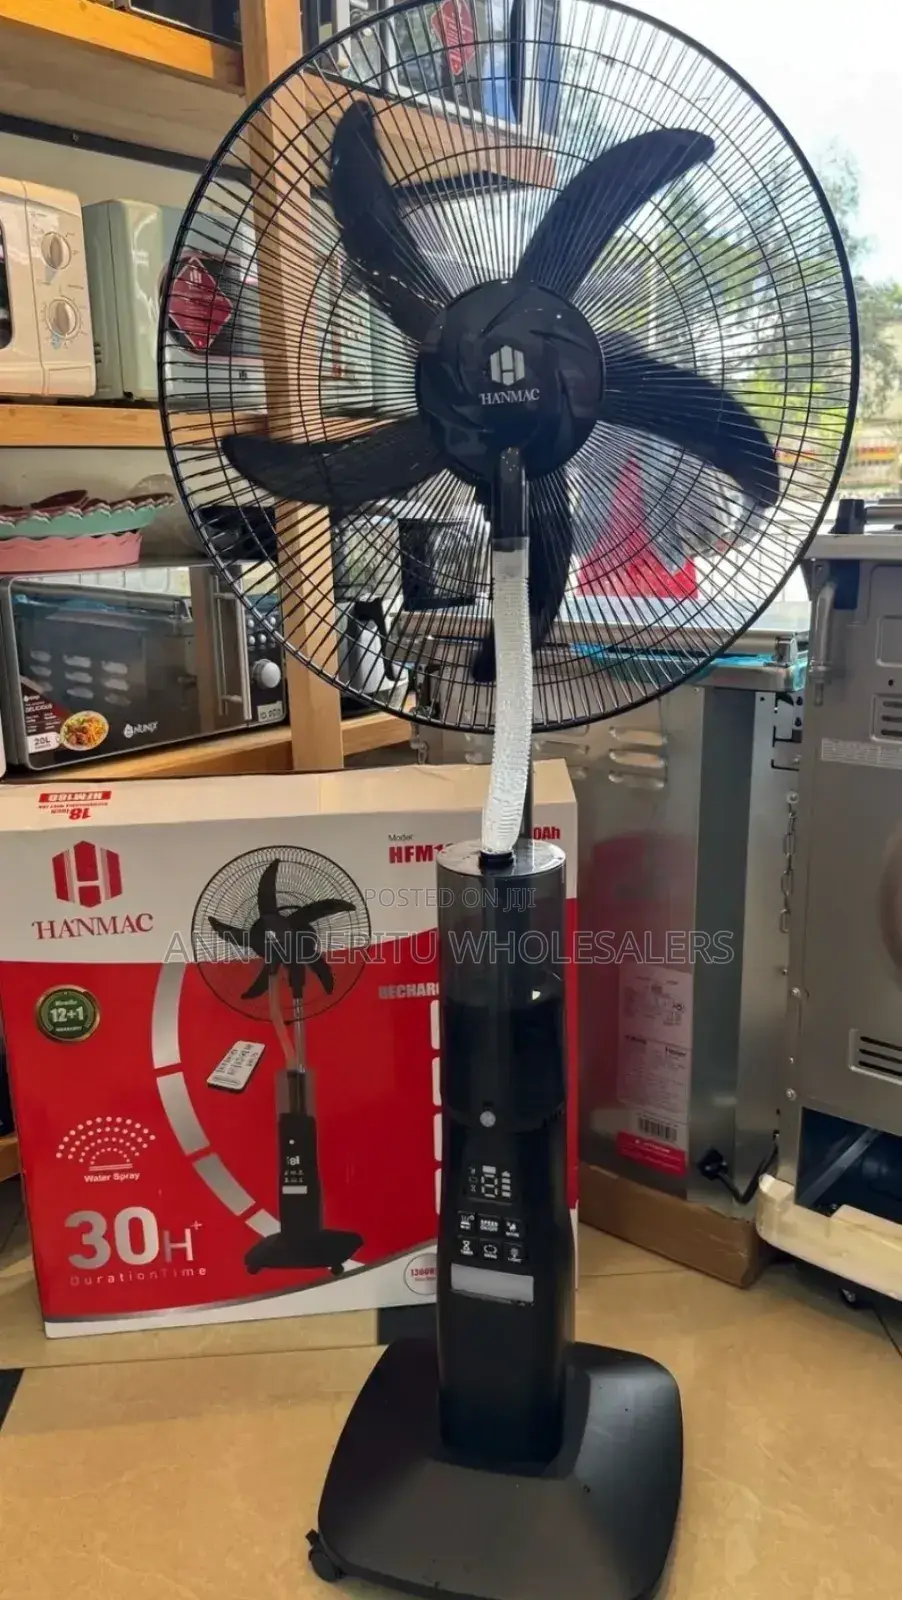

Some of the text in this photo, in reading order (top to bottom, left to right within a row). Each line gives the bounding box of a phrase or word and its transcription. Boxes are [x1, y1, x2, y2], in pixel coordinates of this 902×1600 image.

[479, 388, 540, 405] HANMAC
[69, 808, 91, 820] 18
[32, 913, 154, 940] HANMAC
[50, 1006, 84, 1022] 12+1
[84, 1172, 140, 1183] Water Spray
